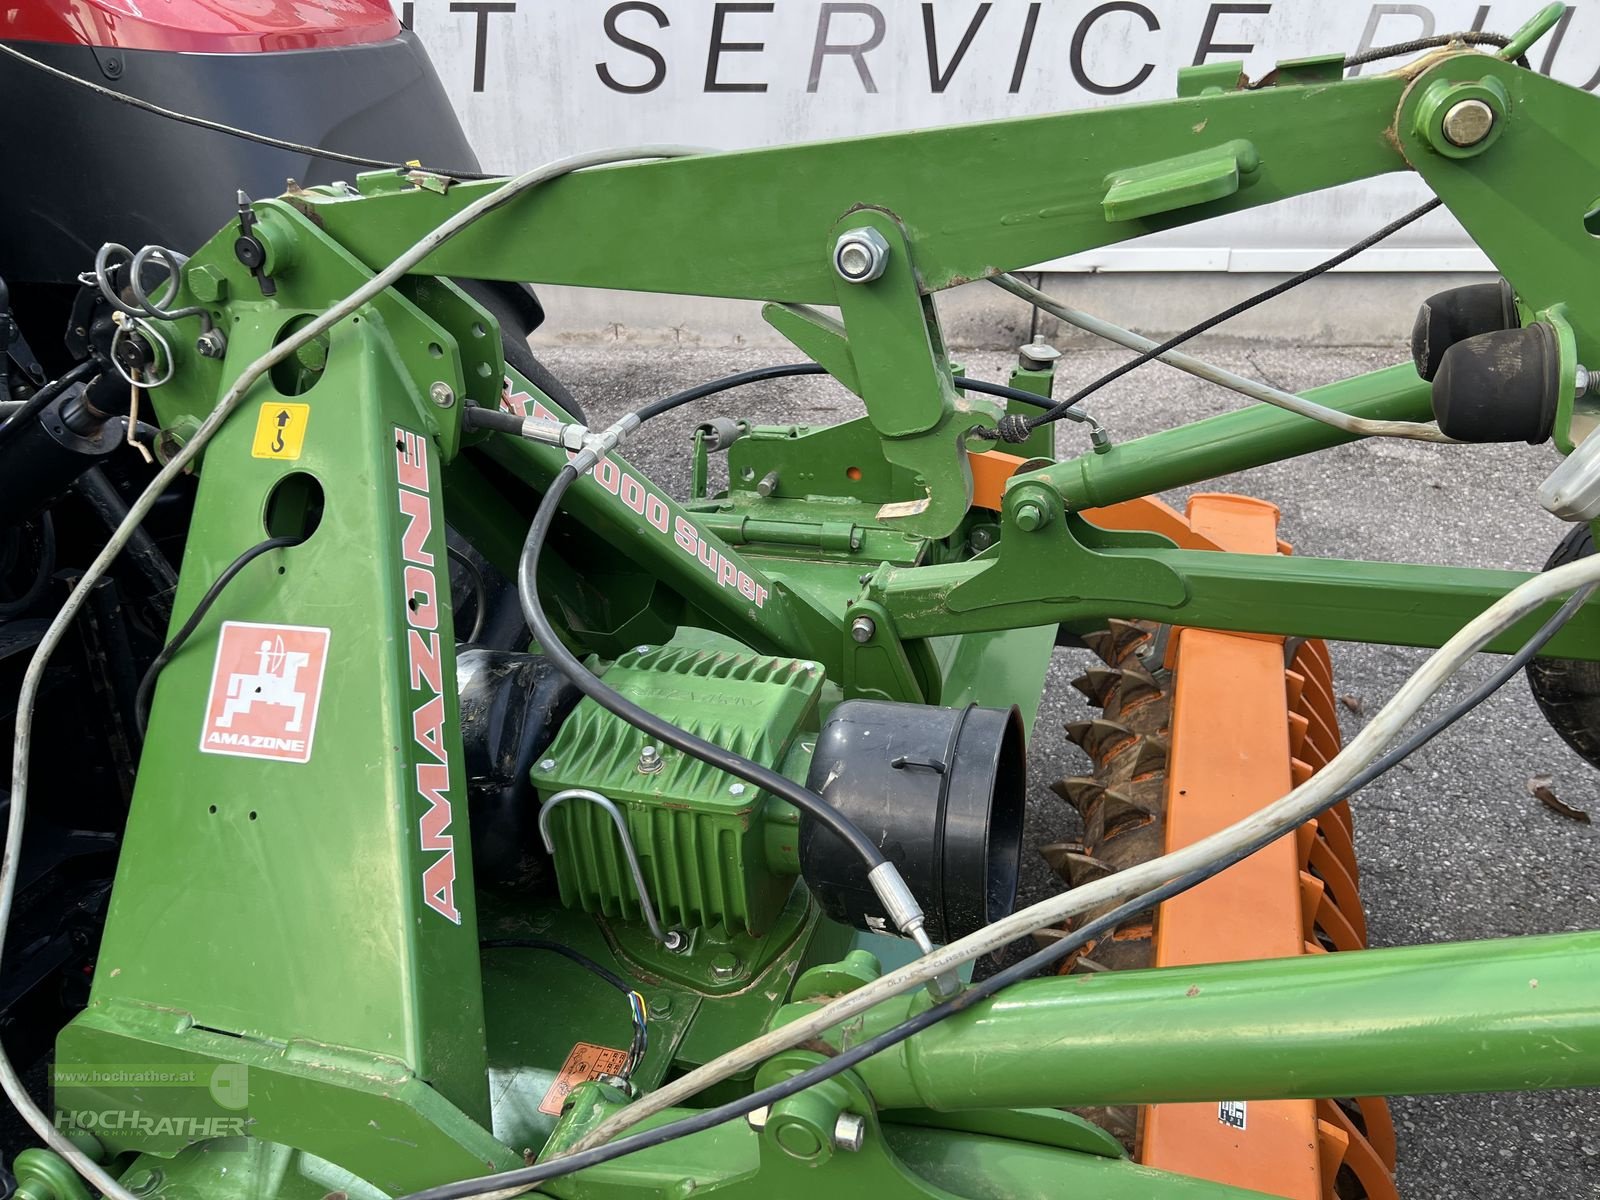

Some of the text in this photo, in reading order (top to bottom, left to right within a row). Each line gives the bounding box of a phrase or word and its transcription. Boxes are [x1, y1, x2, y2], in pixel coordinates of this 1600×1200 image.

[595, 1, 1271, 94] SERVICE
[565, 449, 669, 534] 000
[674, 515, 768, 609] Super
[394, 427, 458, 924] AMAZONE
[207, 731, 305, 752] AMAZONE
[933, 945, 978, 968] CLASSIC
